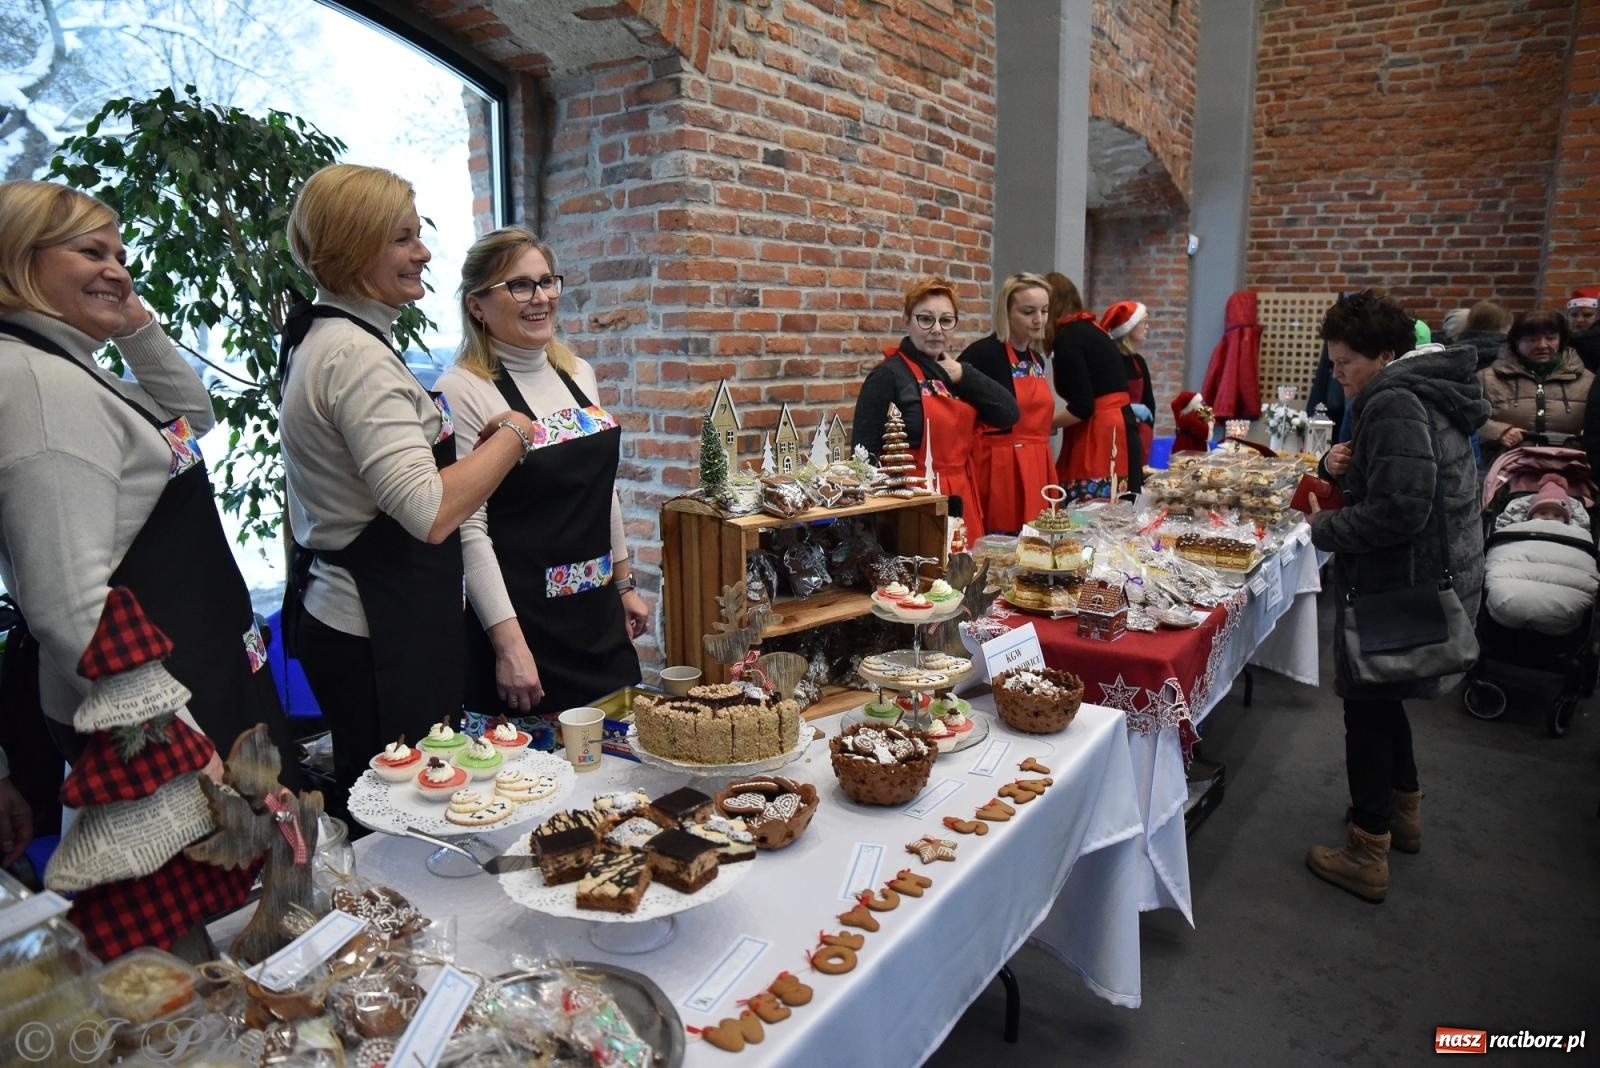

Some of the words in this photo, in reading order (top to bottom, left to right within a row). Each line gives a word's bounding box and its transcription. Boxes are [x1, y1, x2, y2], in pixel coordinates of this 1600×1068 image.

[1005, 648, 1022, 663] KGW
[113, 702, 138, 711] You
[142, 689, 168, 705] don't
[93, 712, 133, 729] points
[136, 704, 160, 717] with
